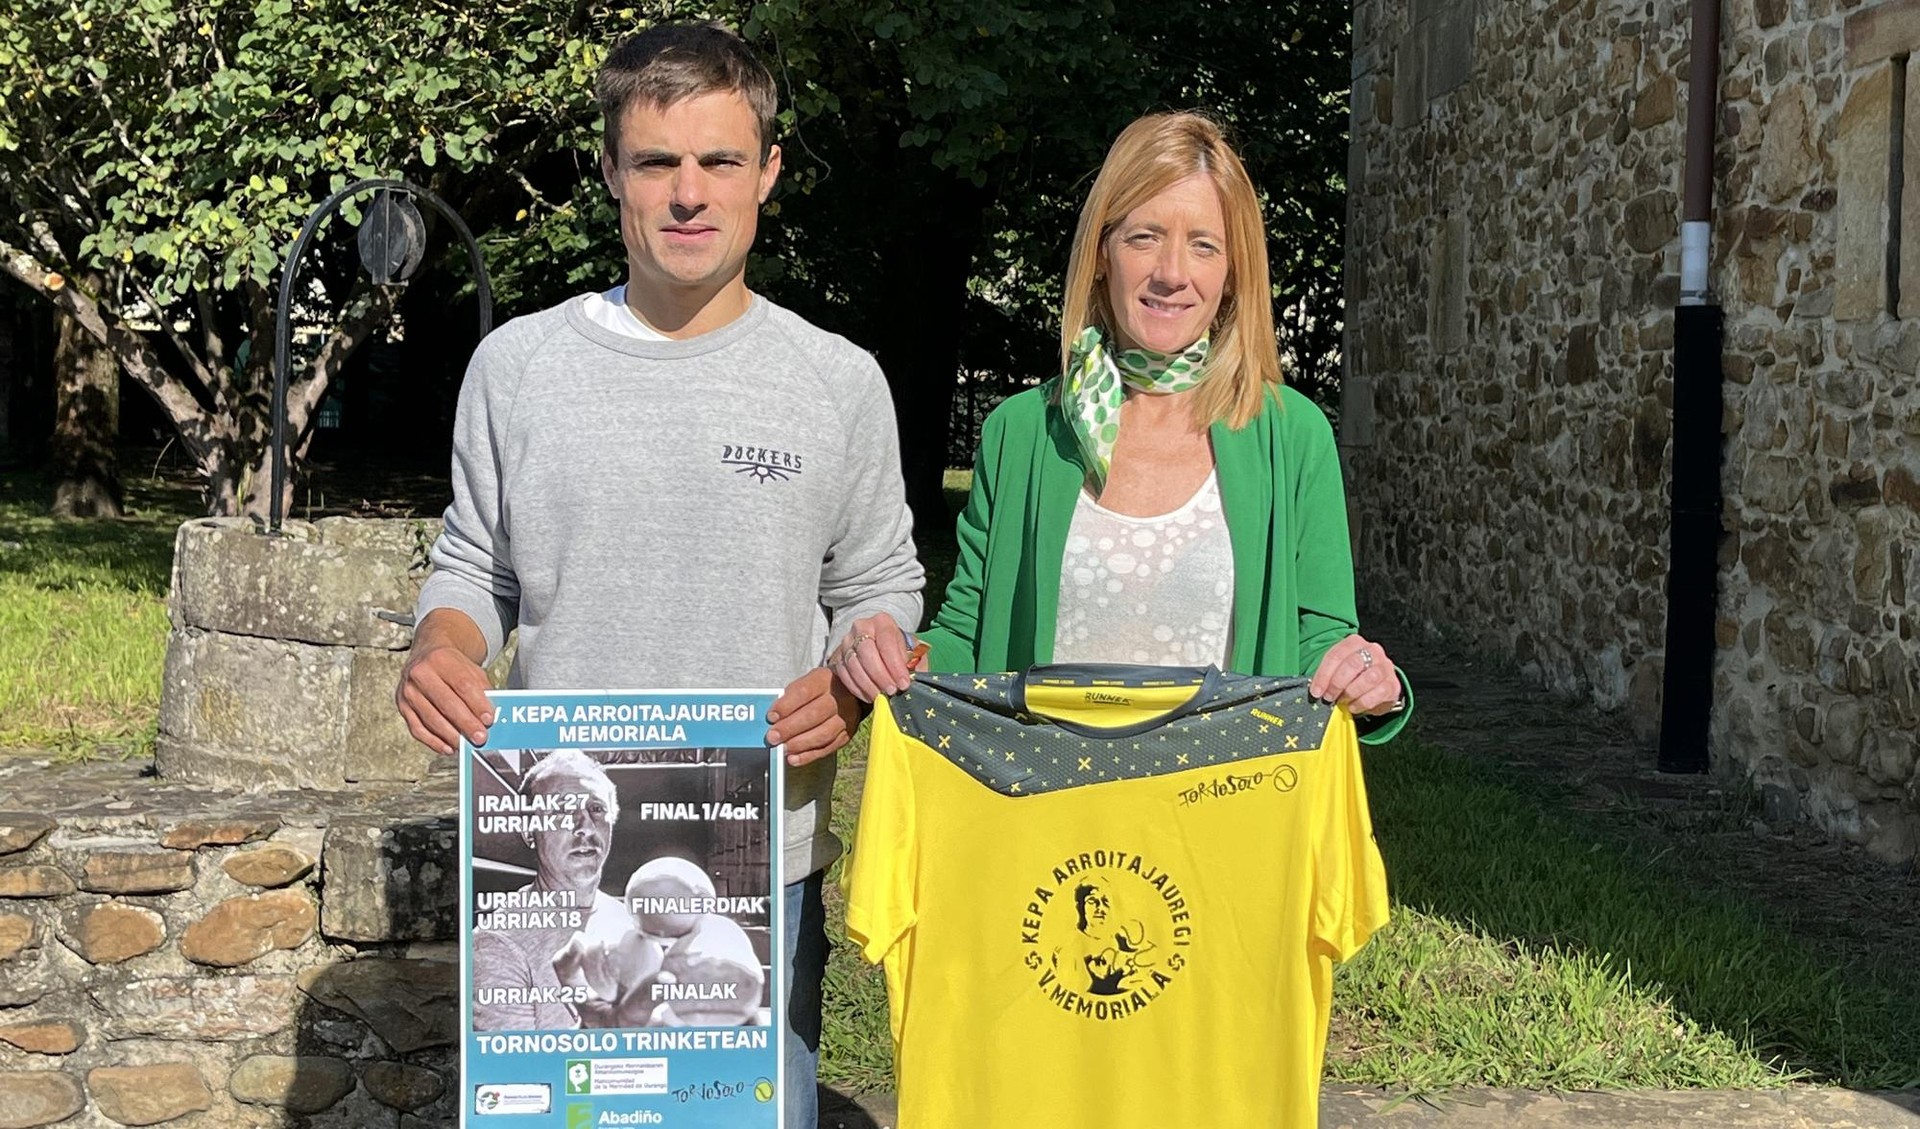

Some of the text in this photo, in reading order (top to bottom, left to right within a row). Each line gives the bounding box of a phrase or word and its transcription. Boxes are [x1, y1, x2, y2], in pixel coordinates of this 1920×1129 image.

[723, 445, 802, 469] DOCKERS
[512, 705, 569, 723] KEPA
[573, 704, 755, 722] ARROITAJAUREGI
[559, 724, 687, 743] MEMORIALA
[478, 793, 590, 812] IRAILAK 27
[640, 802, 759, 820] FINAL 1/4ak
[478, 814, 575, 833] URRIAK 4
[477, 890, 576, 909] URRIAK 11
[632, 896, 765, 914] FINALERDIAK
[1021, 849, 1192, 947] KEPA ARROITAJAUREGI
[477, 911, 582, 930] URRIAK 18
[478, 986, 588, 1005] URRIAK 25
[651, 983, 737, 1000] FINALAK
[476, 1030, 768, 1054] TORNOSOLO TRINKETEAN
[598, 1109, 663, 1125] Abadiño
